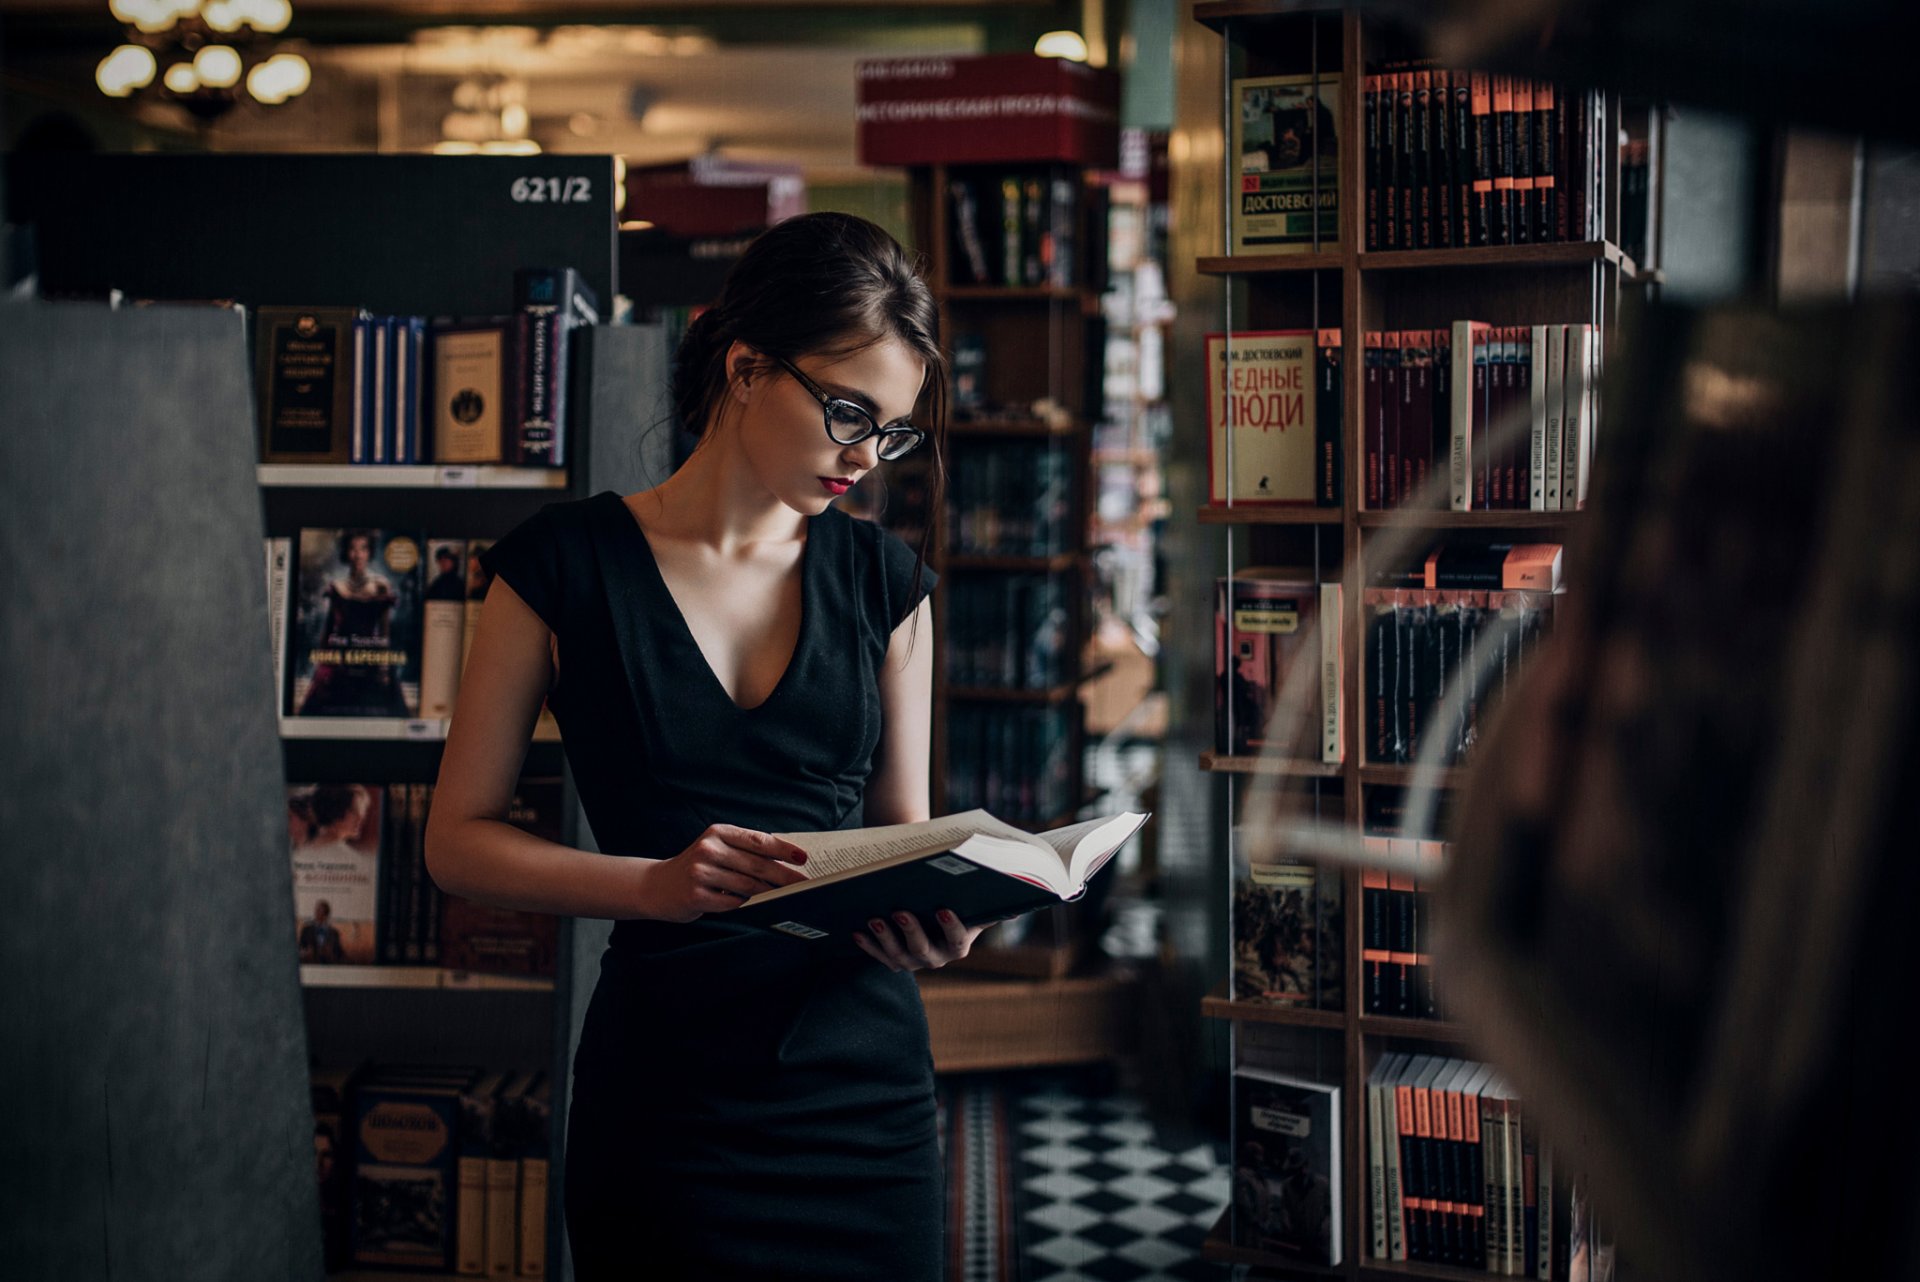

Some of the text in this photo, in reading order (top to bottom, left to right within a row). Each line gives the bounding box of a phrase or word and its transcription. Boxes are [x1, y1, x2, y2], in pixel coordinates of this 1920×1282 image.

[511, 176, 592, 204] 621/2
[1221, 366, 1303, 393] БЕДНЫЕ
[1220, 394, 1304, 433] ЛЮДИ
